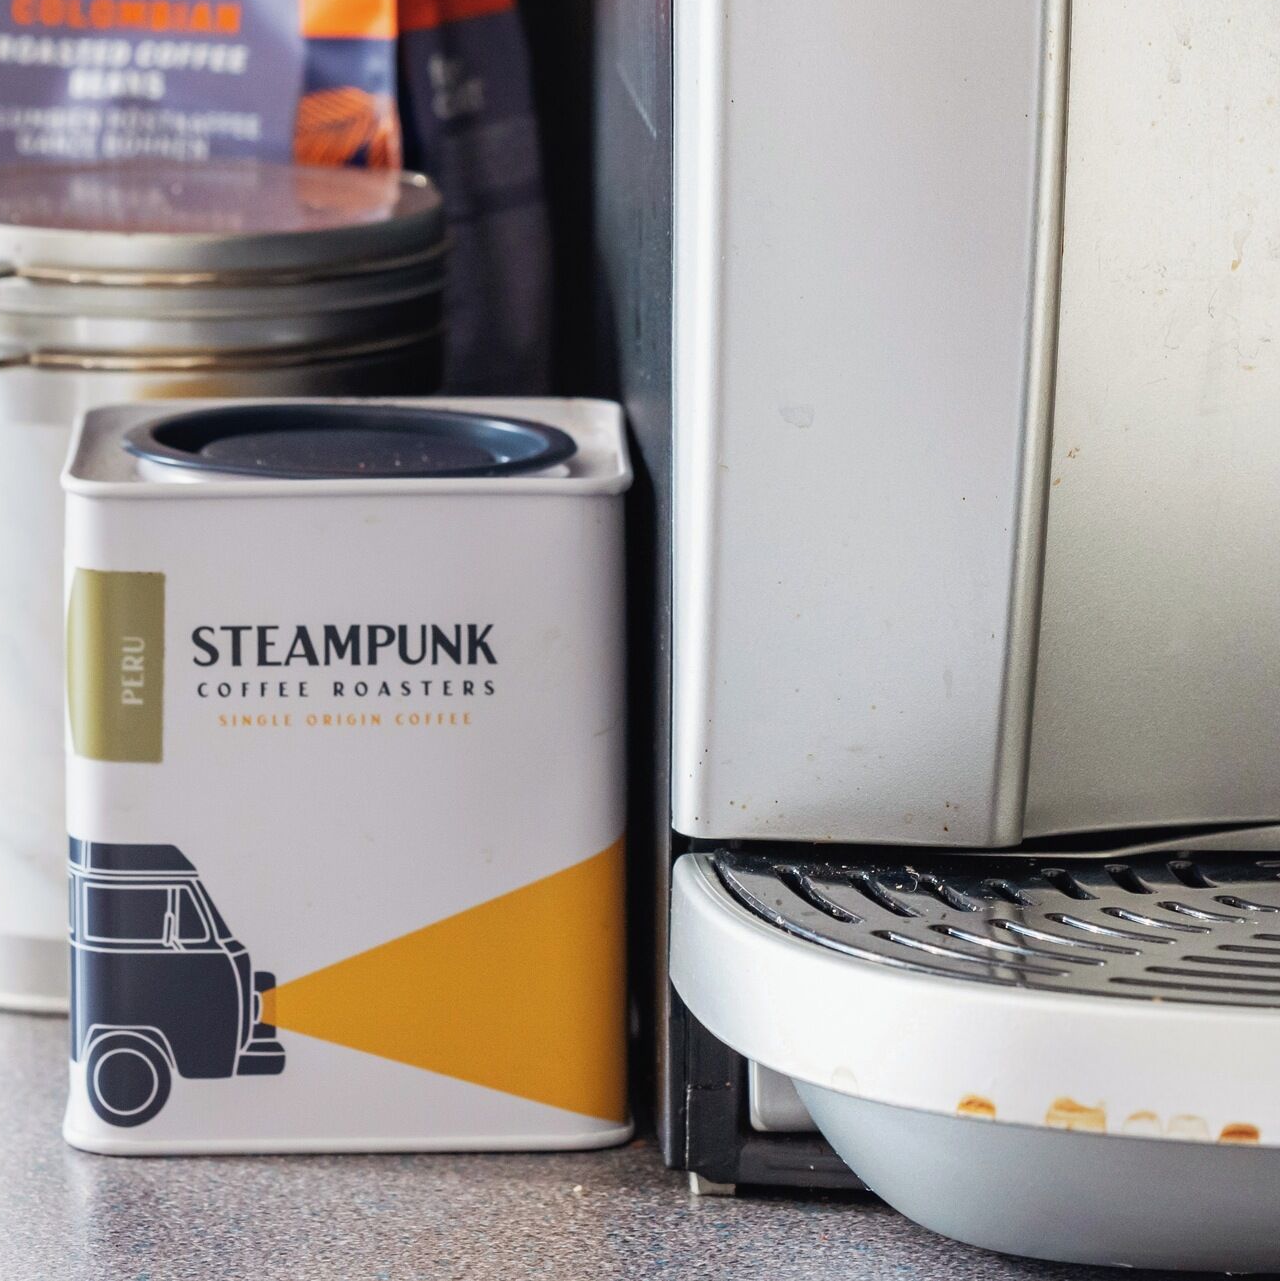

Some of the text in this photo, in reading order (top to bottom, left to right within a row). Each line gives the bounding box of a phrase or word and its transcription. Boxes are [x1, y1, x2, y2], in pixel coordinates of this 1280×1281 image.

[135, 38, 249, 76] COFFEE
[191, 623, 499, 667] STEAMPUNK
[121, 635, 145, 705] PERU
[197, 679, 496, 698] COFFEE ROASTERS
[218, 711, 473, 727] SINGLE ORIGIN COFFEE
